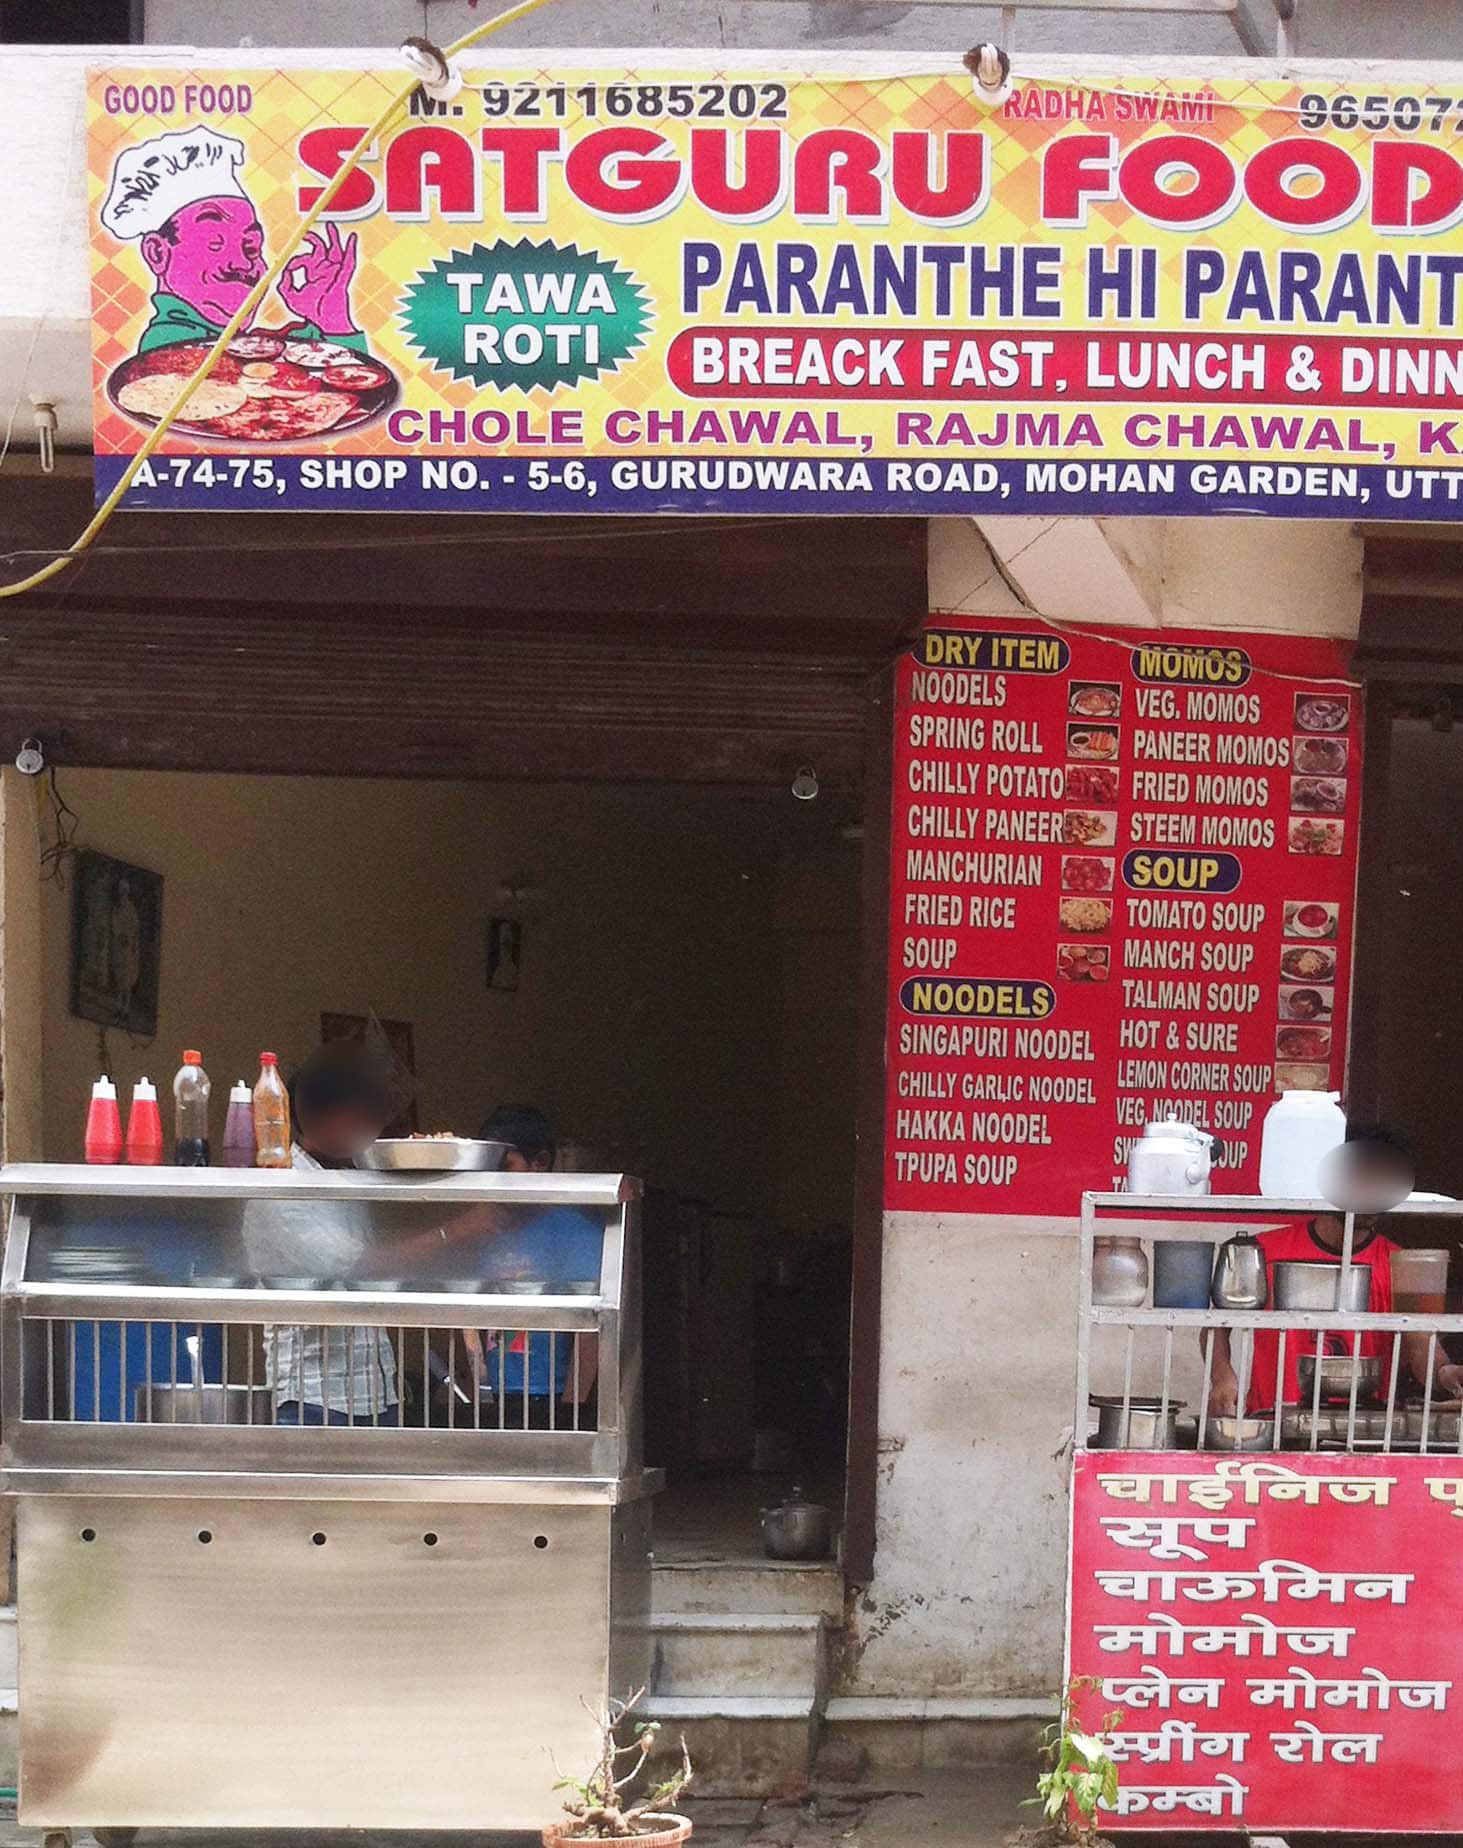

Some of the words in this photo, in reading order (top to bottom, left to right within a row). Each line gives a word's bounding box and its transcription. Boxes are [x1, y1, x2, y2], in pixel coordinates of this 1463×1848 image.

[105, 86, 176, 114] GOOD
[185, 86, 252, 114] FOOD
[409, 86, 464, 116] M.
[483, 83, 788, 118] 9211685202
[1003, 91, 1106, 120] RADHA
[1115, 92, 1214, 122] SWAMI
[298, 126, 990, 225] SATGURU
[1041, 135, 1463, 232] FOOD
[446, 272, 617, 313] TAWA
[684, 242, 1061, 318] PARANTHE
[1088, 248, 1157, 318] HI
[463, 324, 600, 365] ROTI
[691, 336, 904, 386] BREACK
[922, 340, 1067, 394] FAST,
[1087, 342, 1265, 390] LUNCH
[1286, 345, 1322, 393] &
[1341, 346, 1463, 396] DINN
[388, 410, 584, 444] CHOLE
[605, 410, 874, 454] CHAWAL,
[896, 412, 1102, 448] RAJMA
[1124, 414, 1396, 460] CHAWAL,
[1419, 420, 1463, 454] K
[130, 459, 286, 496] A-74-75,
[301, 459, 408, 488] SHOP
[423, 460, 491, 489] NO.
[529, 462, 597, 496] 5-6,
[609, 461, 872, 492] GURUDWARA
[887, 463, 1010, 499] ROAD,
[1025, 463, 1175, 494] MOHAN
[1190, 467, 1371, 504] GARDEN,
[925, 634, 982, 664] DRY
[992, 637, 1060, 671] ITEM
[1140, 645, 1242, 682] MOMOS
[911, 671, 1008, 708] NOODELS
[1135, 687, 1181, 720] VEG.
[1187, 692, 1261, 725] MOMOS
[909, 715, 985, 750] SPRING
[992, 719, 1043, 753] ROLL
[1133, 729, 1211, 763] PANEER
[1216, 734, 1290, 768] MOMOS
[908, 759, 981, 795] CHILLY
[986, 763, 1064, 799] POTATO
[1132, 770, 1190, 803] FRIED
[1195, 774, 1268, 807] MOMOS
[908, 804, 979, 840] CHILLY
[985, 809, 1063, 843] PANEER
[1130, 813, 1197, 845] STEEM
[1202, 816, 1275, 849] MOMOS
[906, 849, 1042, 886] MANCHURIAN
[1132, 853, 1220, 889] SOUP
[904, 894, 961, 927] FRIED
[969, 896, 1016, 929] RICE
[1126, 899, 1207, 932] TOMATO
[1211, 903, 1265, 934] SOUP
[902, 937, 957, 970] SOUP
[1123, 938, 1196, 971] MANCH
[1200, 942, 1254, 974] SOUP
[912, 981, 1050, 1018] NOODELS
[1122, 979, 1201, 1011] TALMAN
[1206, 982, 1260, 1014] SOUP
[899, 1023, 1009, 1059] SINGAPURI
[1015, 1028, 1095, 1062] NOODEL
[1120, 1020, 1161, 1050] HOT
[1165, 1023, 1181, 1050] &
[1186, 1023, 1238, 1053] SURE
[898, 1071, 957, 1101] CHILLY
[962, 1074, 1024, 1104] GARLIC
[1029, 1076, 1097, 1105] NOODEL
[1117, 1060, 1167, 1090] LEMON
[1171, 1063, 1229, 1092] CORNER
[1233, 1065, 1272, 1094] SOUP
[896, 1109, 965, 1142] HAKKA
[972, 1112, 1052, 1145] NOODEL
[1214, 1101, 1253, 1130] SOUP
[894, 1152, 958, 1184] TPUPA
[964, 1155, 1018, 1186] SOUP
[1211, 1141, 1248, 1169] OUP
[1097, 1462, 1397, 1510] चाईनिज
[1100, 1517, 1256, 1561] सूप
[1094, 1559, 1415, 1605] चाऊमिन
[1093, 1612, 1356, 1657] मोमोज
[1100, 1665, 1226, 1708] प्लेन
[1246, 1666, 1453, 1711] मोमोज
[1269, 1721, 1384, 1763] रोल
[1097, 1774, 1250, 1816] कम्बो
